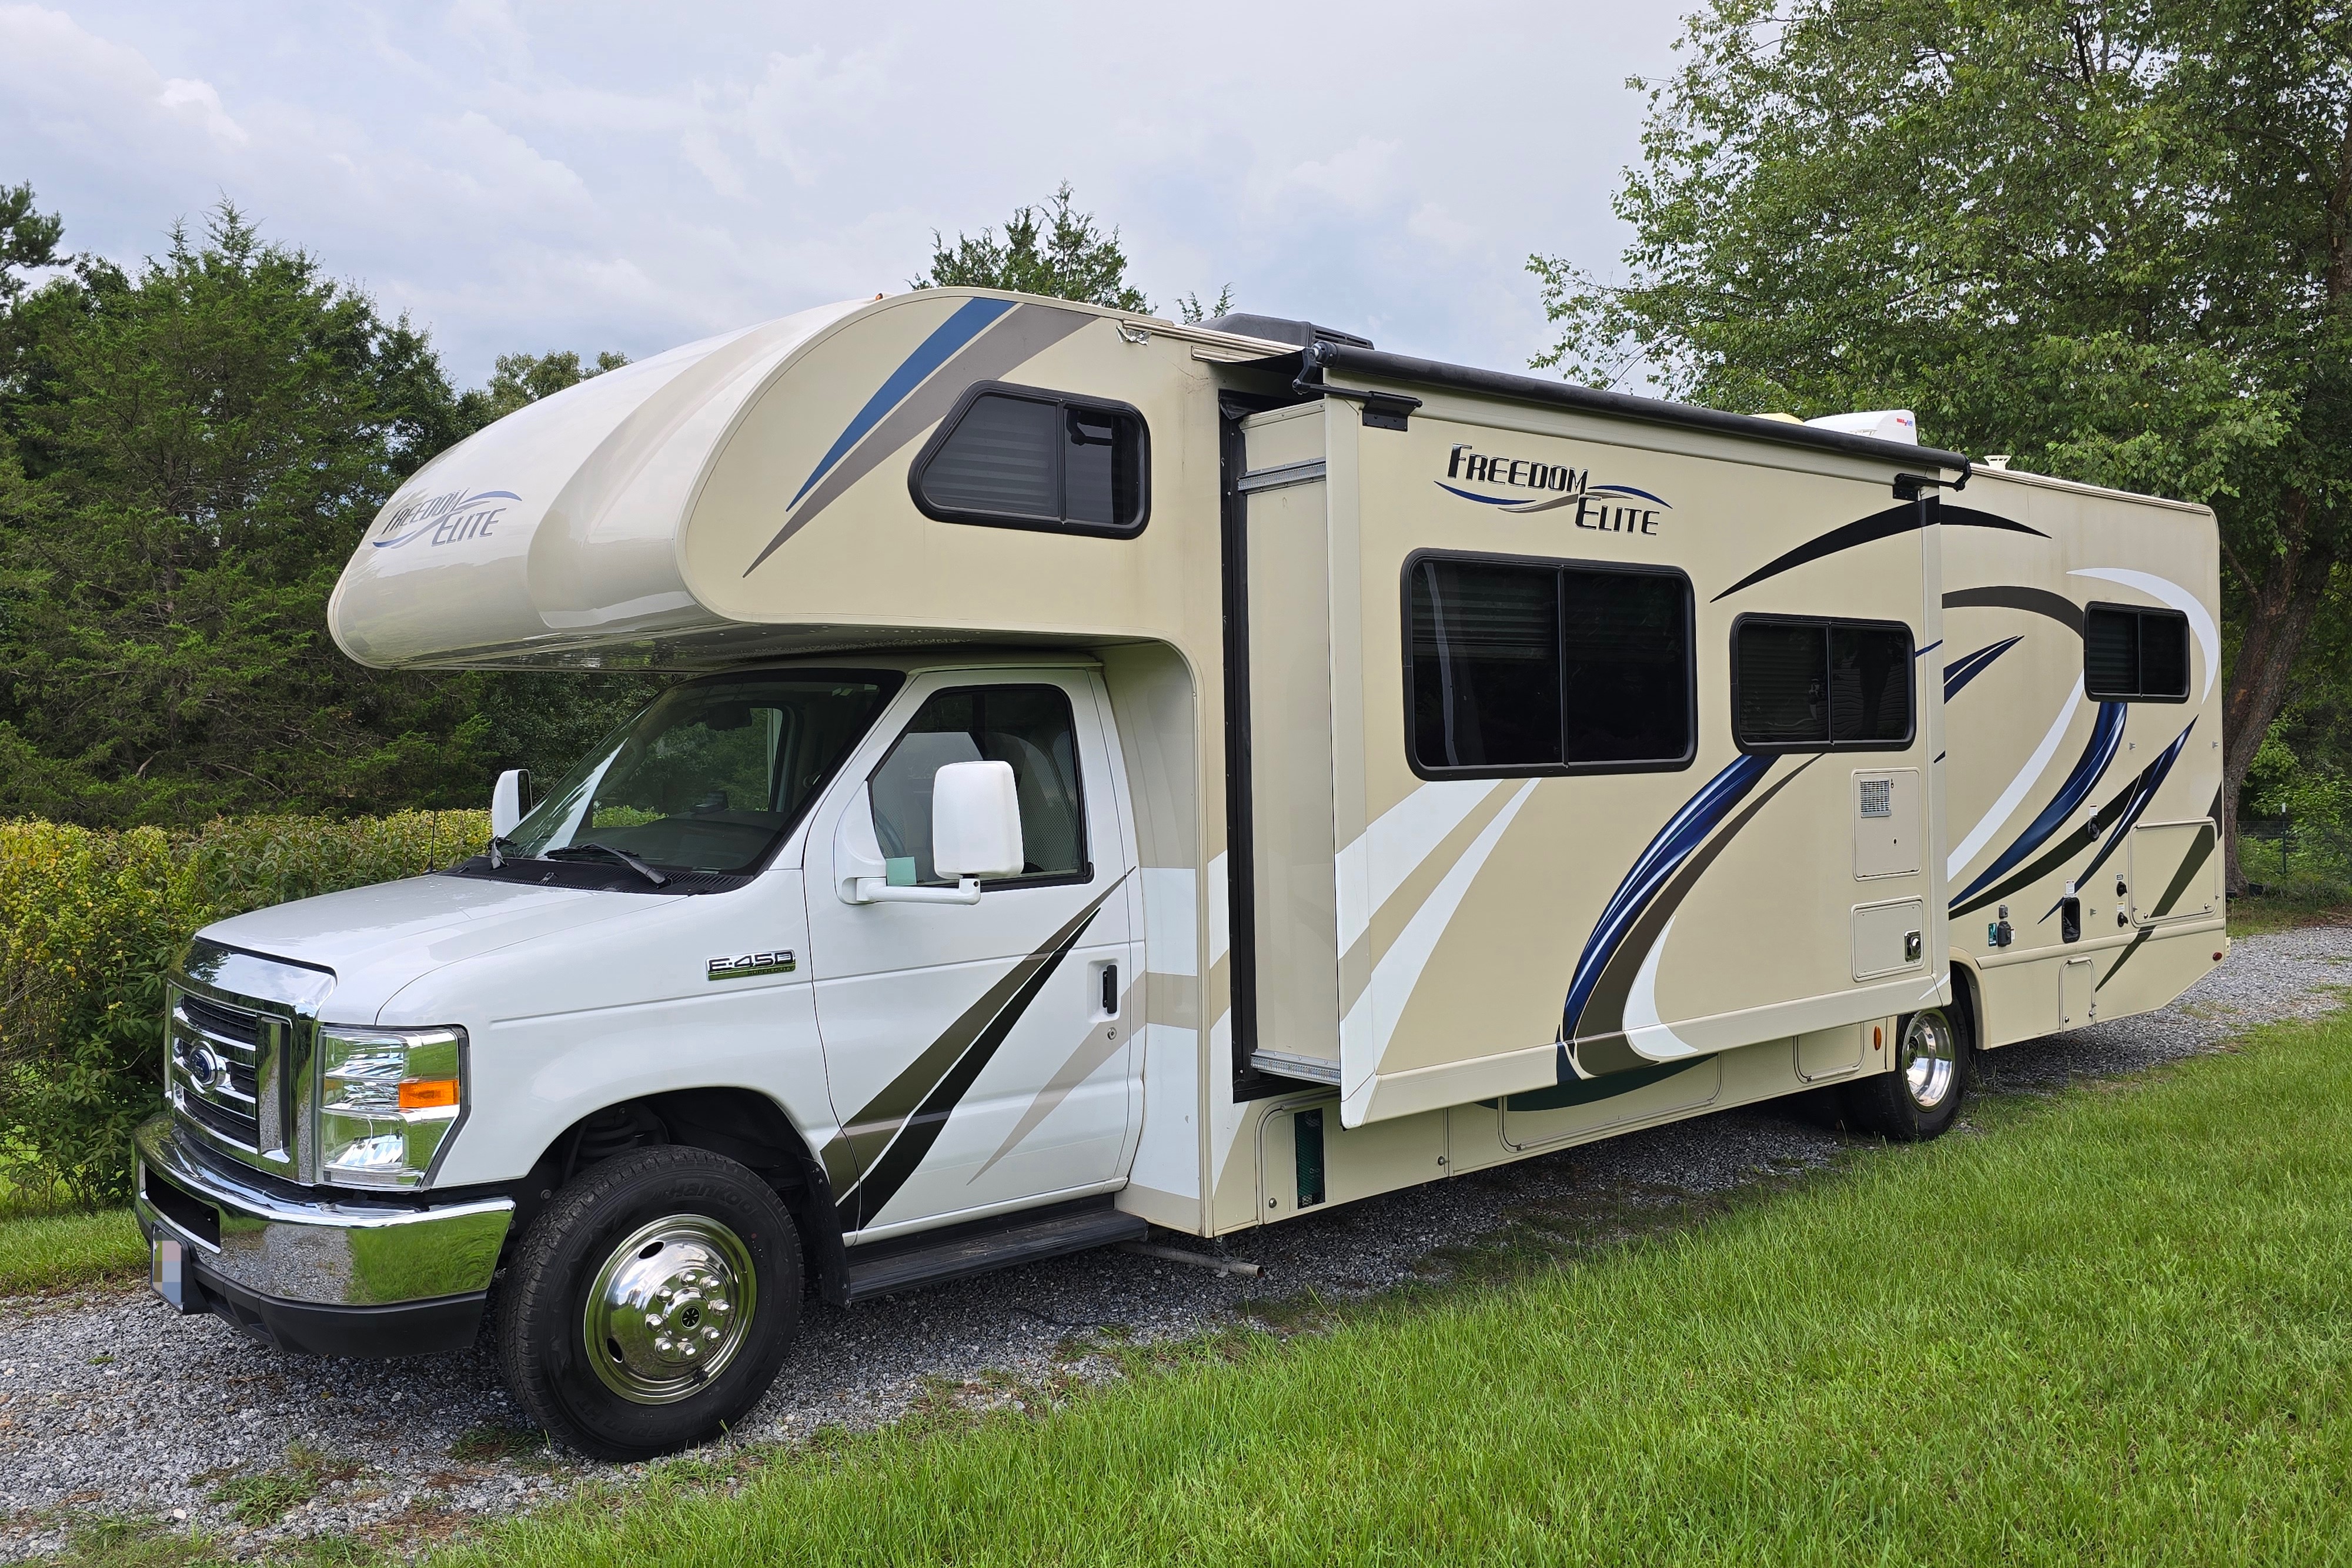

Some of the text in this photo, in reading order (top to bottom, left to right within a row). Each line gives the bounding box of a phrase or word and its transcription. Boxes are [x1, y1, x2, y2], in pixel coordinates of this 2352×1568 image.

[1447, 443, 1588, 494] FREEDOM
[381, 487, 470, 536] FREEDOM
[431, 508, 507, 547] ELITE
[1575, 495, 1660, 536] ELITE
